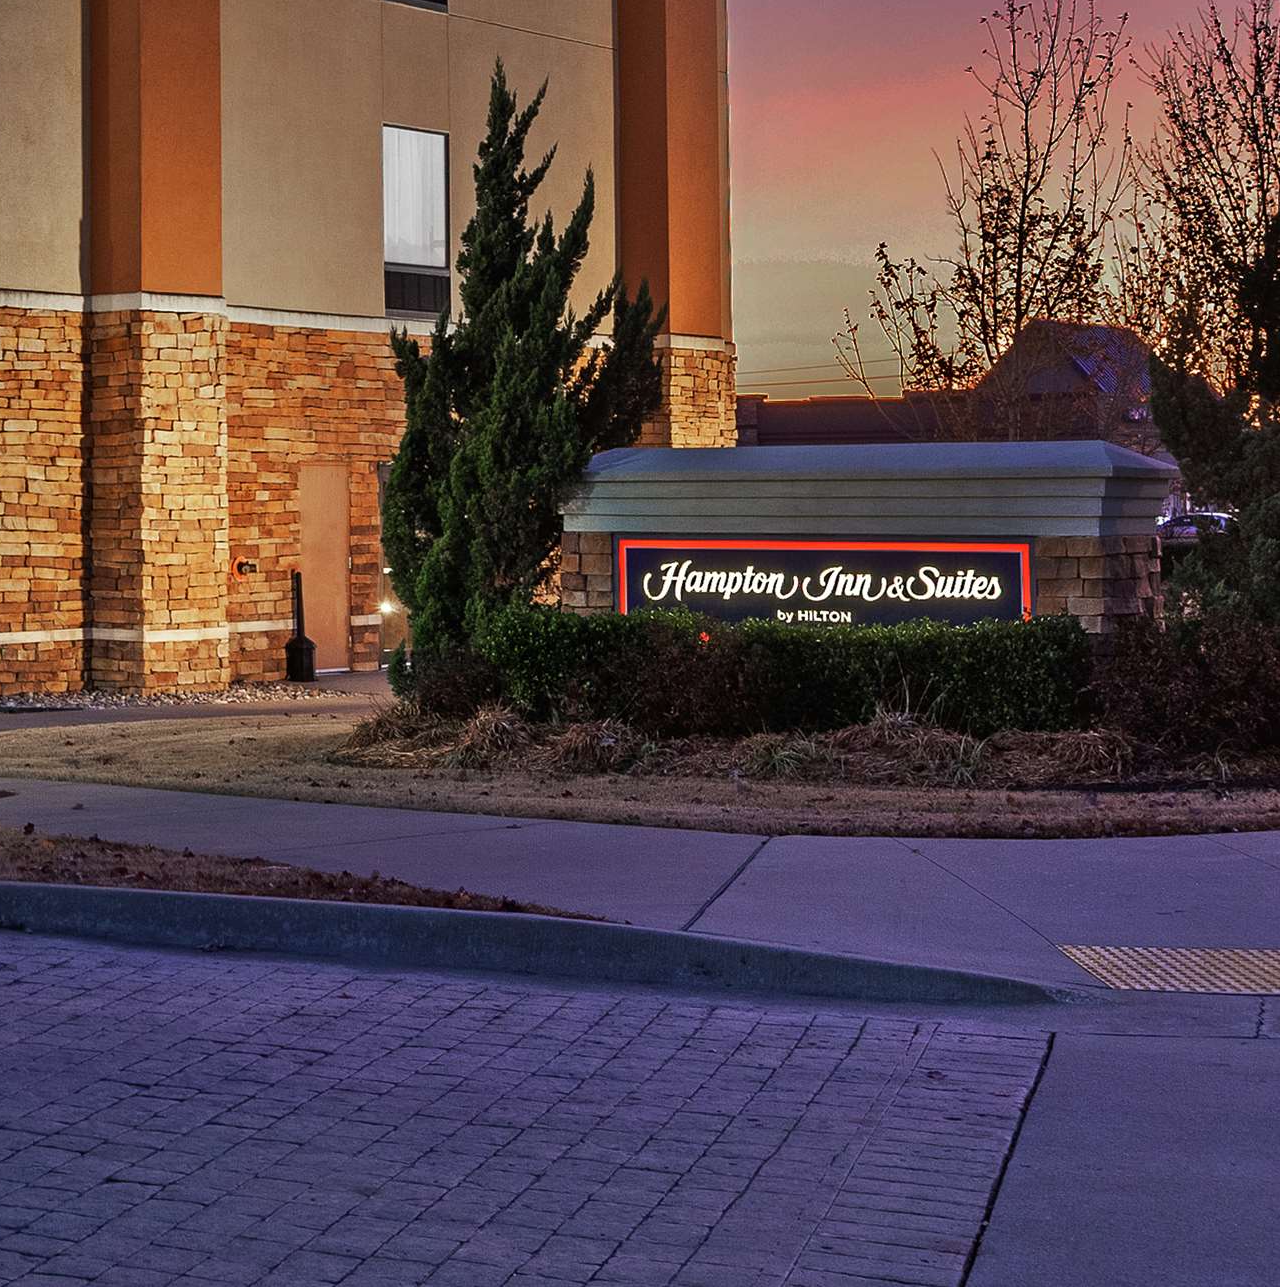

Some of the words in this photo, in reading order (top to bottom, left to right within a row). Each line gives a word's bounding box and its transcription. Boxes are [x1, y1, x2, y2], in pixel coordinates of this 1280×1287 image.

[642, 559, 799, 602] Hampton
[801, 565, 887, 602] Inn
[886, 575, 911, 602] &
[906, 565, 1003, 601] Suites
[776, 609, 794, 624] by
[797, 609, 852, 623] HILTON
